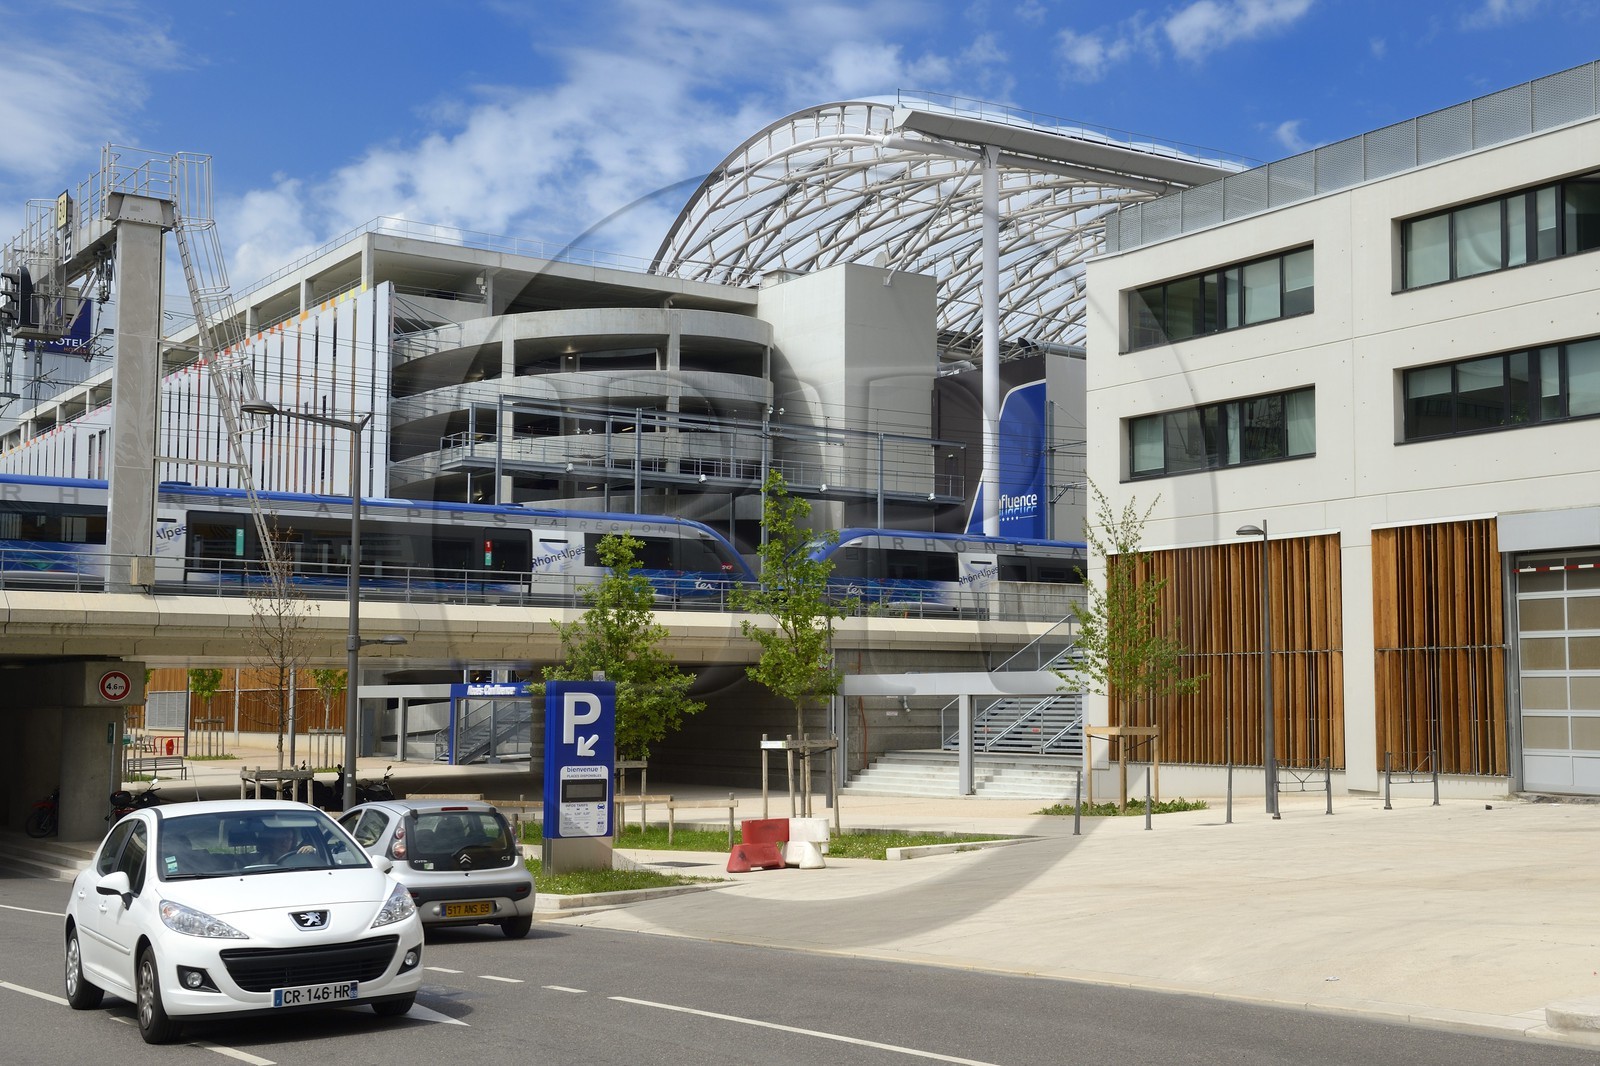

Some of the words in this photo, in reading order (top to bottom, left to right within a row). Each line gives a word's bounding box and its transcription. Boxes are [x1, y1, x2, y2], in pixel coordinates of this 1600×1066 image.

[28, 338, 87, 348] OTEL
[563, 692, 602, 744] P
[447, 905, 461, 915] 517
[463, 904, 478, 914] ANS
[480, 903, 490, 913] 69
